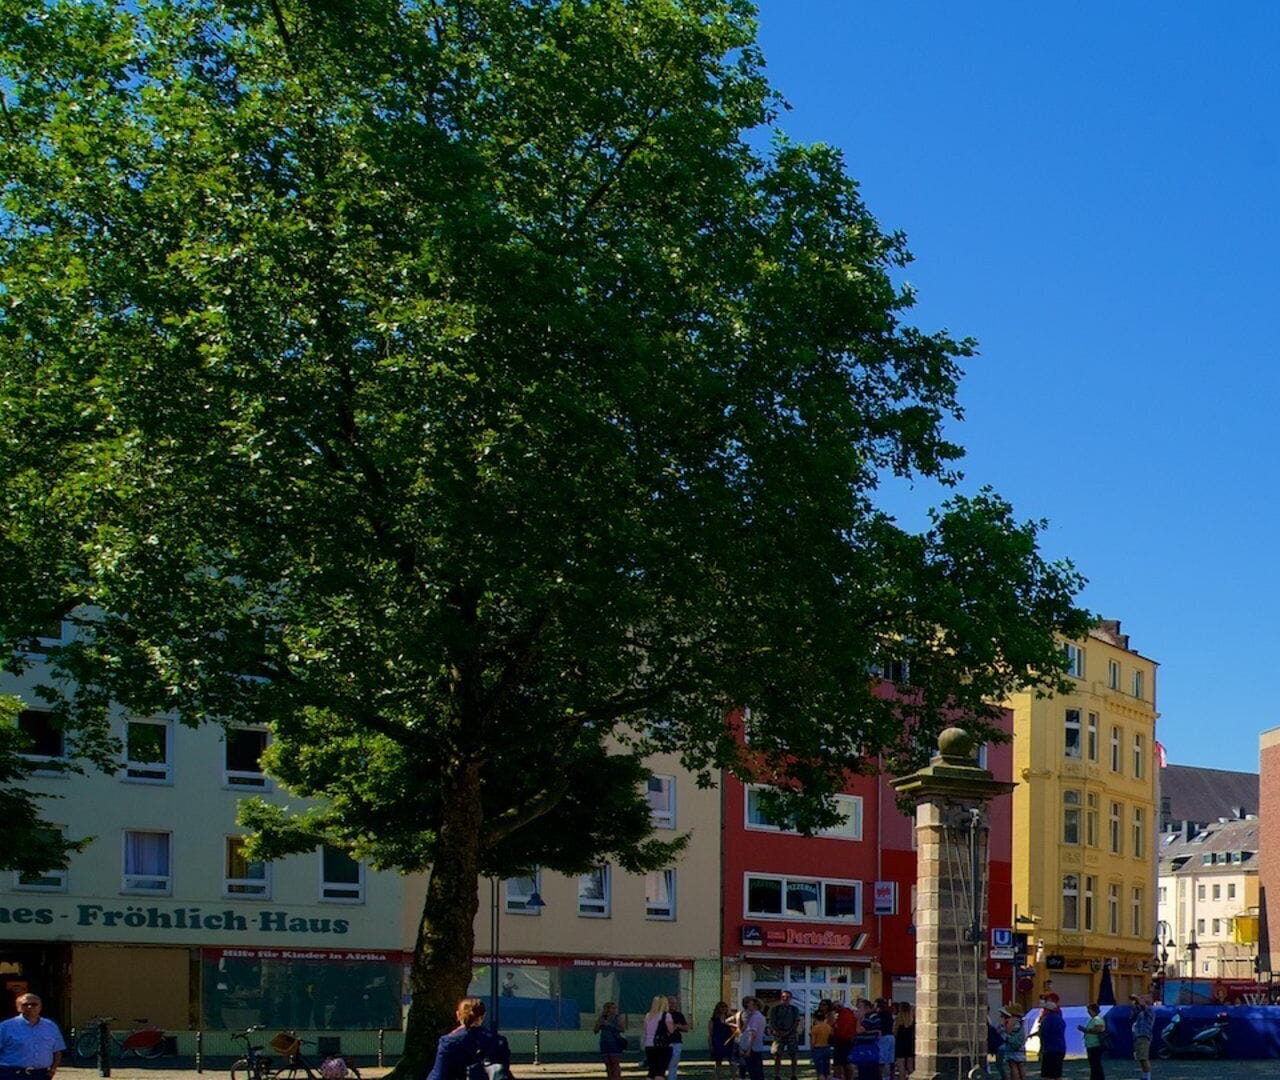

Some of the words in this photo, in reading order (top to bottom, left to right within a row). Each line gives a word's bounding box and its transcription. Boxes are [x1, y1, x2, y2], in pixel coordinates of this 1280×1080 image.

[996, 931, 1010, 945] U
[222, 949, 255, 958] Hilfe
[257, 950, 279, 958] für
[282, 951, 325, 960] Kinder
[328, 952, 342, 960] in
[345, 953, 387, 961] Afrika
